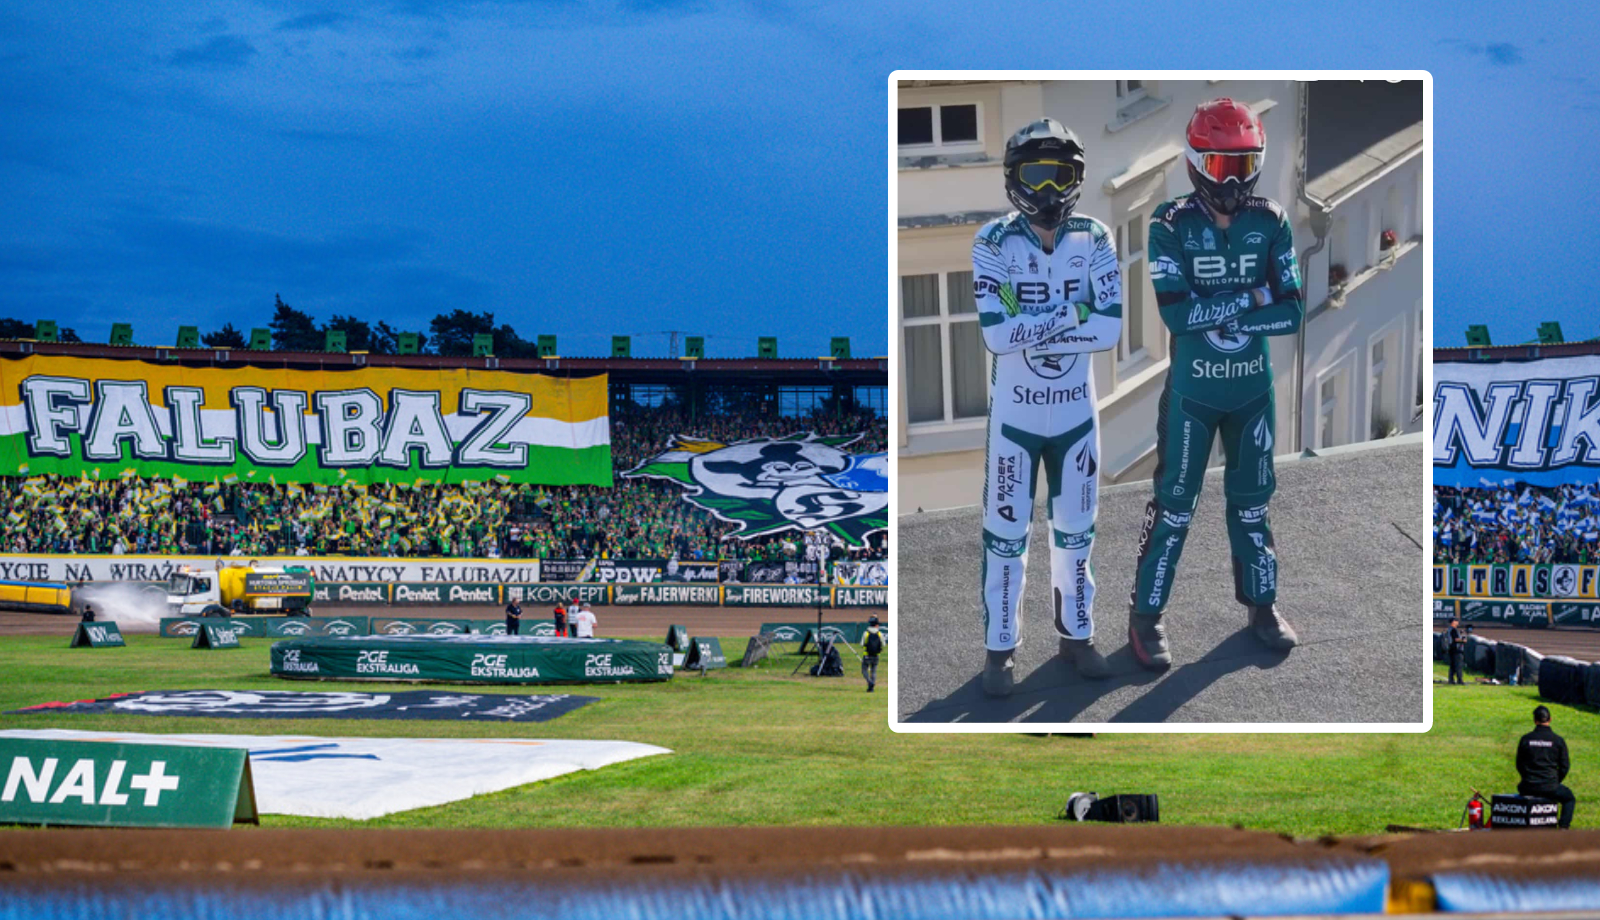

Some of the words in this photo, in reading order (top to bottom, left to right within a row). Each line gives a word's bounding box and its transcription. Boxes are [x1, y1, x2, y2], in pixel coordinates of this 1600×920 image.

[1194, 277, 1256, 286] DEVELOPMENT
[1187, 302, 1238, 325] iluzja
[1009, 317, 1056, 343] iluzja
[1192, 354, 1264, 378] Stelmet
[1013, 382, 1088, 405] Stelmet
[20, 375, 532, 465] FALUBAZ
[1178, 421, 1191, 483] FELGENHAUER
[996, 456, 1008, 501] BADER
[1007, 455, 1018, 493] KARA
[65, 563, 94, 581] NA
[420, 566, 533, 583] FALUBAZU
[600, 567, 657, 583] PDW
[1433, 567, 1550, 594] ULTRAS
[339, 585, 384, 601] Pentel
[396, 585, 441, 601] Pentel
[450, 585, 494, 601] Pentel
[527, 586, 606, 602] KONCEPT
[640, 587, 718, 602] FAJERWERKI
[743, 587, 812, 603] FIREWORKS
[837, 588, 888, 605] FAJERW
[1002, 565, 1010, 629] FELGENHAUER
[1076, 559, 1089, 629] Streamsoft
[356, 650, 389, 663] PGE
[471, 654, 508, 667] PGE
[585, 654, 613, 666] PGE
[356, 662, 419, 674] EKSTRALIGA
[471, 666, 540, 678] EKSTRALIGA
[585, 665, 635, 677] EKSTRALIGA
[0, 756, 180, 807] NAL+
[1492, 816, 1526, 825] REKLAMA
